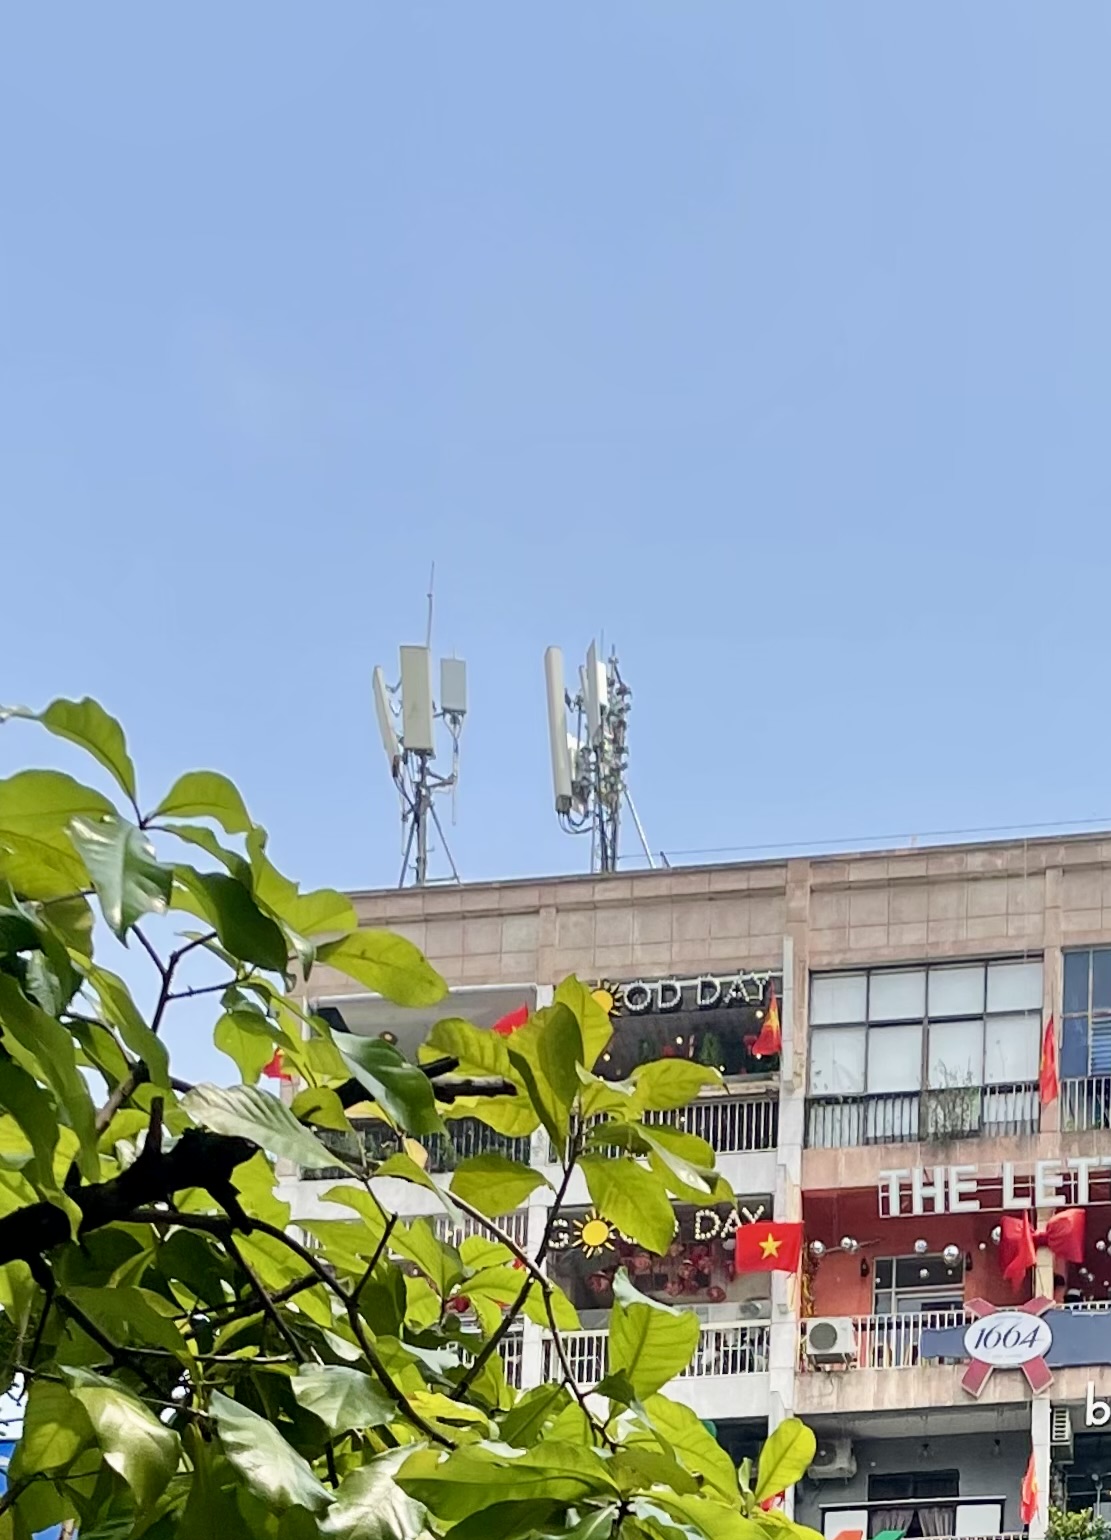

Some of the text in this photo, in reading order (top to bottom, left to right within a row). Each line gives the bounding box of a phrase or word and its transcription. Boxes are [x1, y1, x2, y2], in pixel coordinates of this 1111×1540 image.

[697, 971, 770, 1006] DAY
[880, 1163, 981, 1216] THE
[973, 1320, 1043, 1350] 1664
